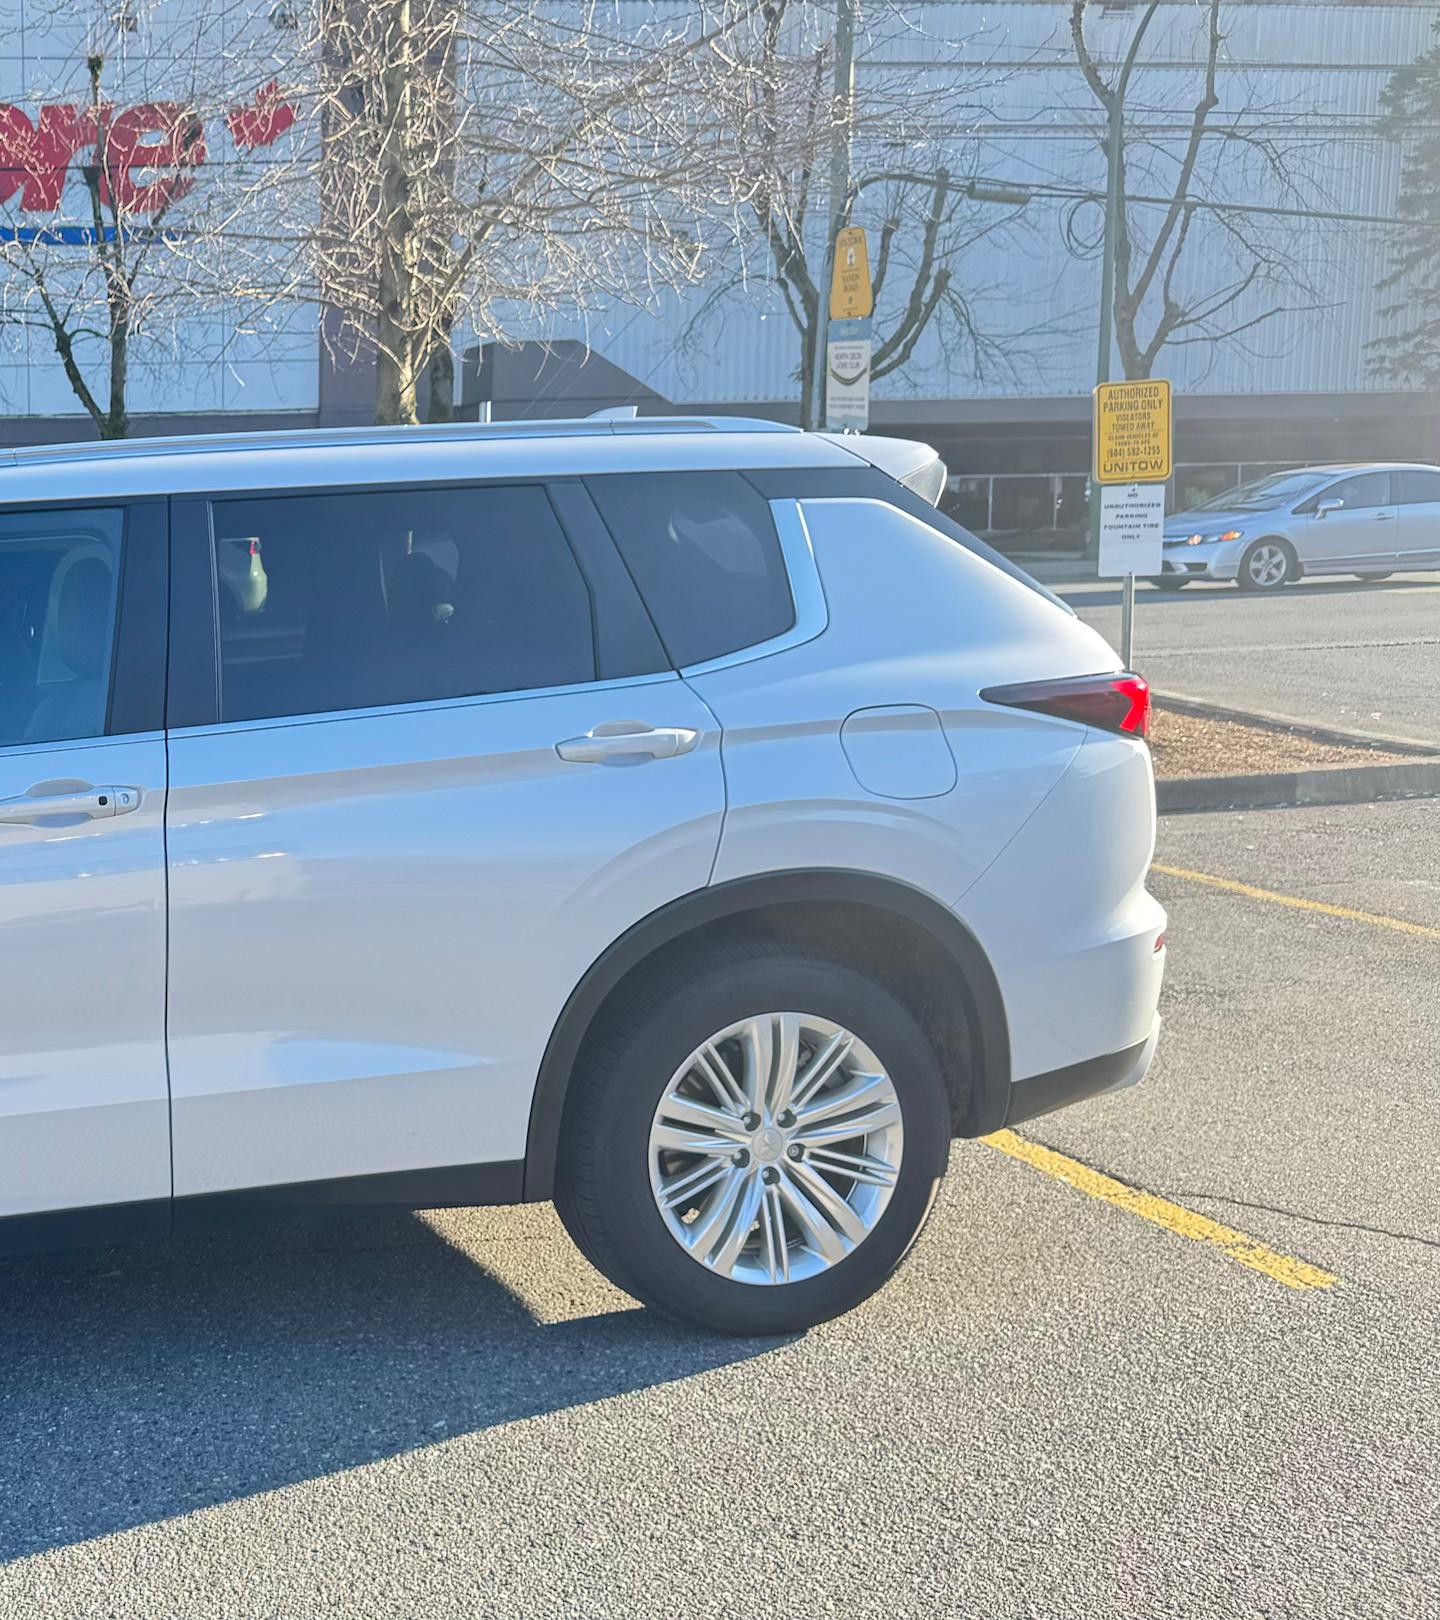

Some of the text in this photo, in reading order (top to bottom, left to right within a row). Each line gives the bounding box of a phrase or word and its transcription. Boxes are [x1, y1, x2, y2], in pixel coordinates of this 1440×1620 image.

[1108, 387, 1159, 400] AUTHORIZED
[1103, 398, 1164, 413] PARKING ONLY
[1116, 412, 1151, 422] VIOLATORS
[1111, 422, 1155, 432] TOWED AWAY
[1103, 460, 1164, 473] UNITOW
